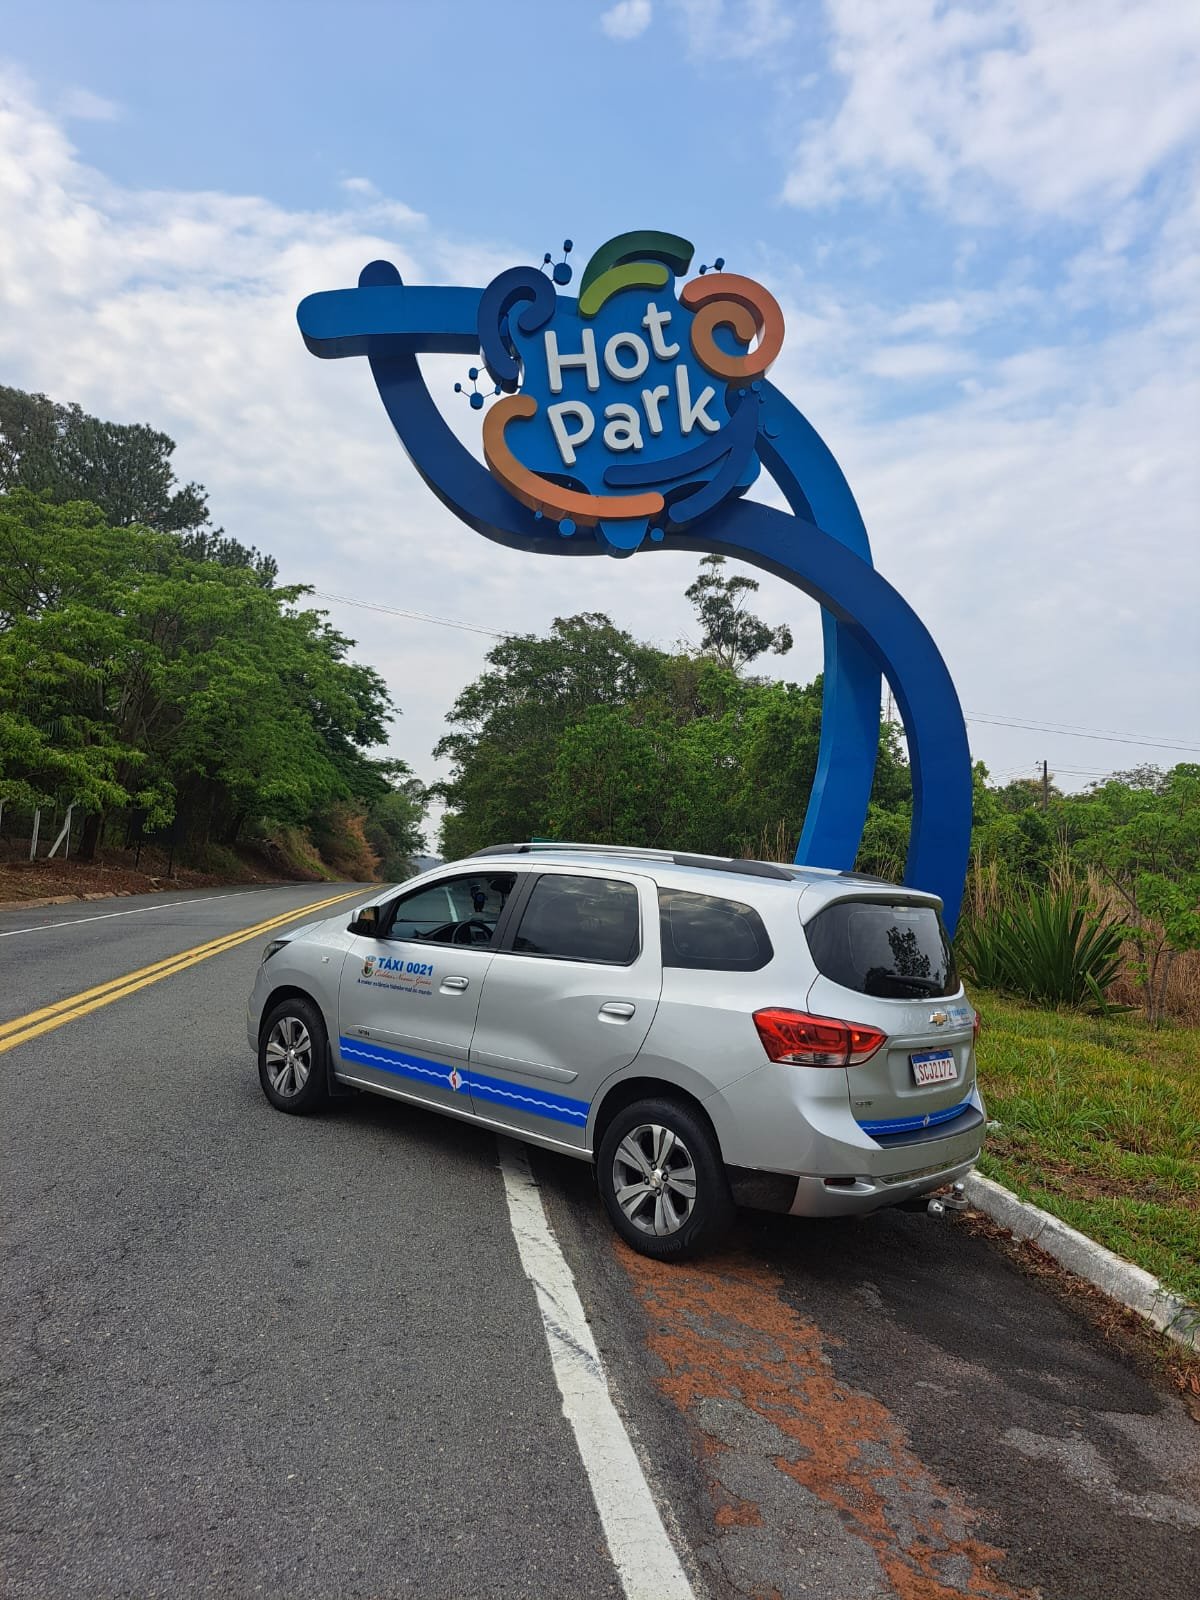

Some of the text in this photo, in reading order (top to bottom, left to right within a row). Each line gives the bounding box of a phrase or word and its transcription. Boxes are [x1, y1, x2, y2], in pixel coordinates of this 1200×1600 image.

[544, 302, 680, 394] Hot
[547, 364, 721, 467] Park
[378, 956, 434, 976] TÁXI 0021
